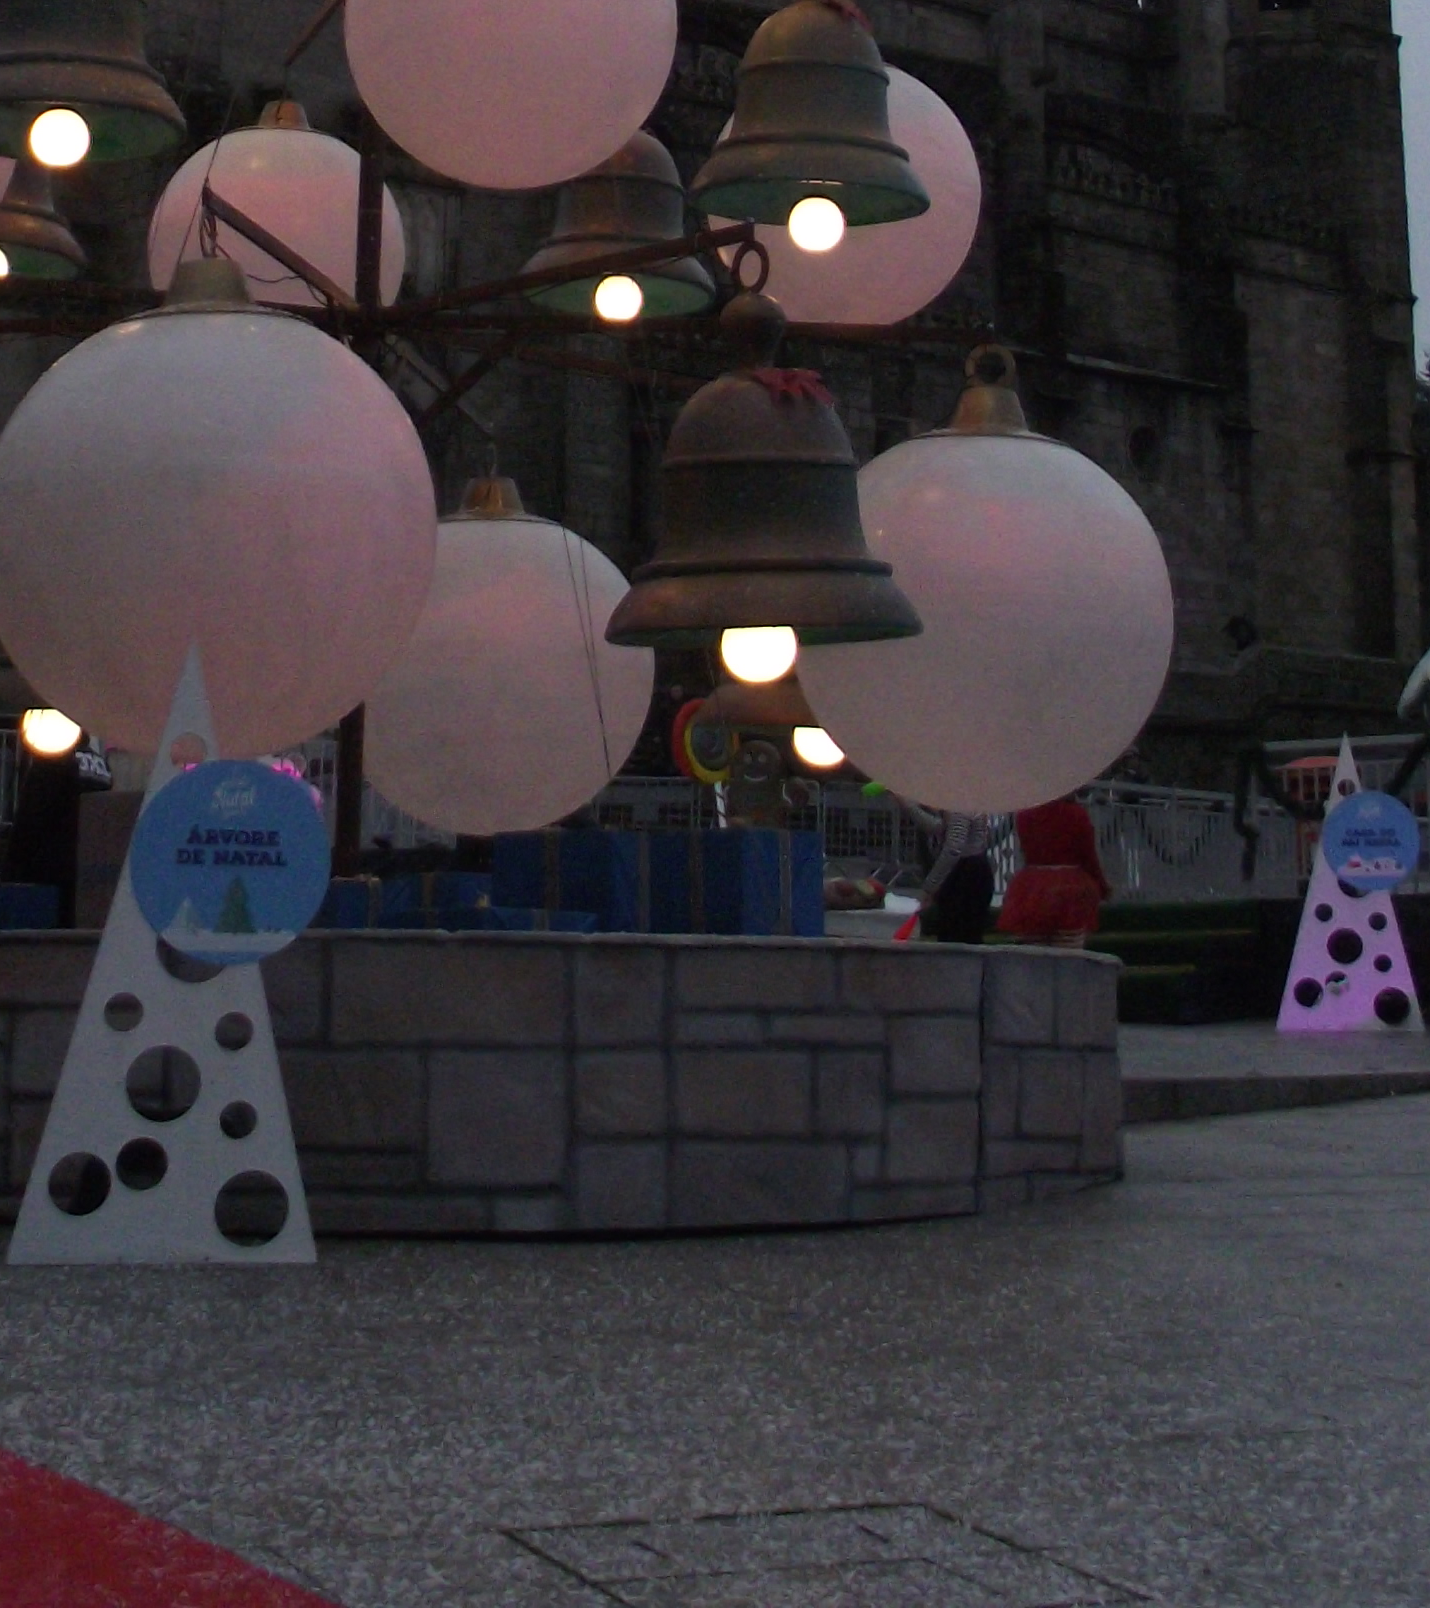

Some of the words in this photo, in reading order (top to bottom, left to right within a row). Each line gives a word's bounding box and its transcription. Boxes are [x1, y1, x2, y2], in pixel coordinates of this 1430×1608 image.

[187, 824, 280, 847] ÁRVORE
[177, 848, 205, 865] DE
[213, 850, 288, 867] NATAL
